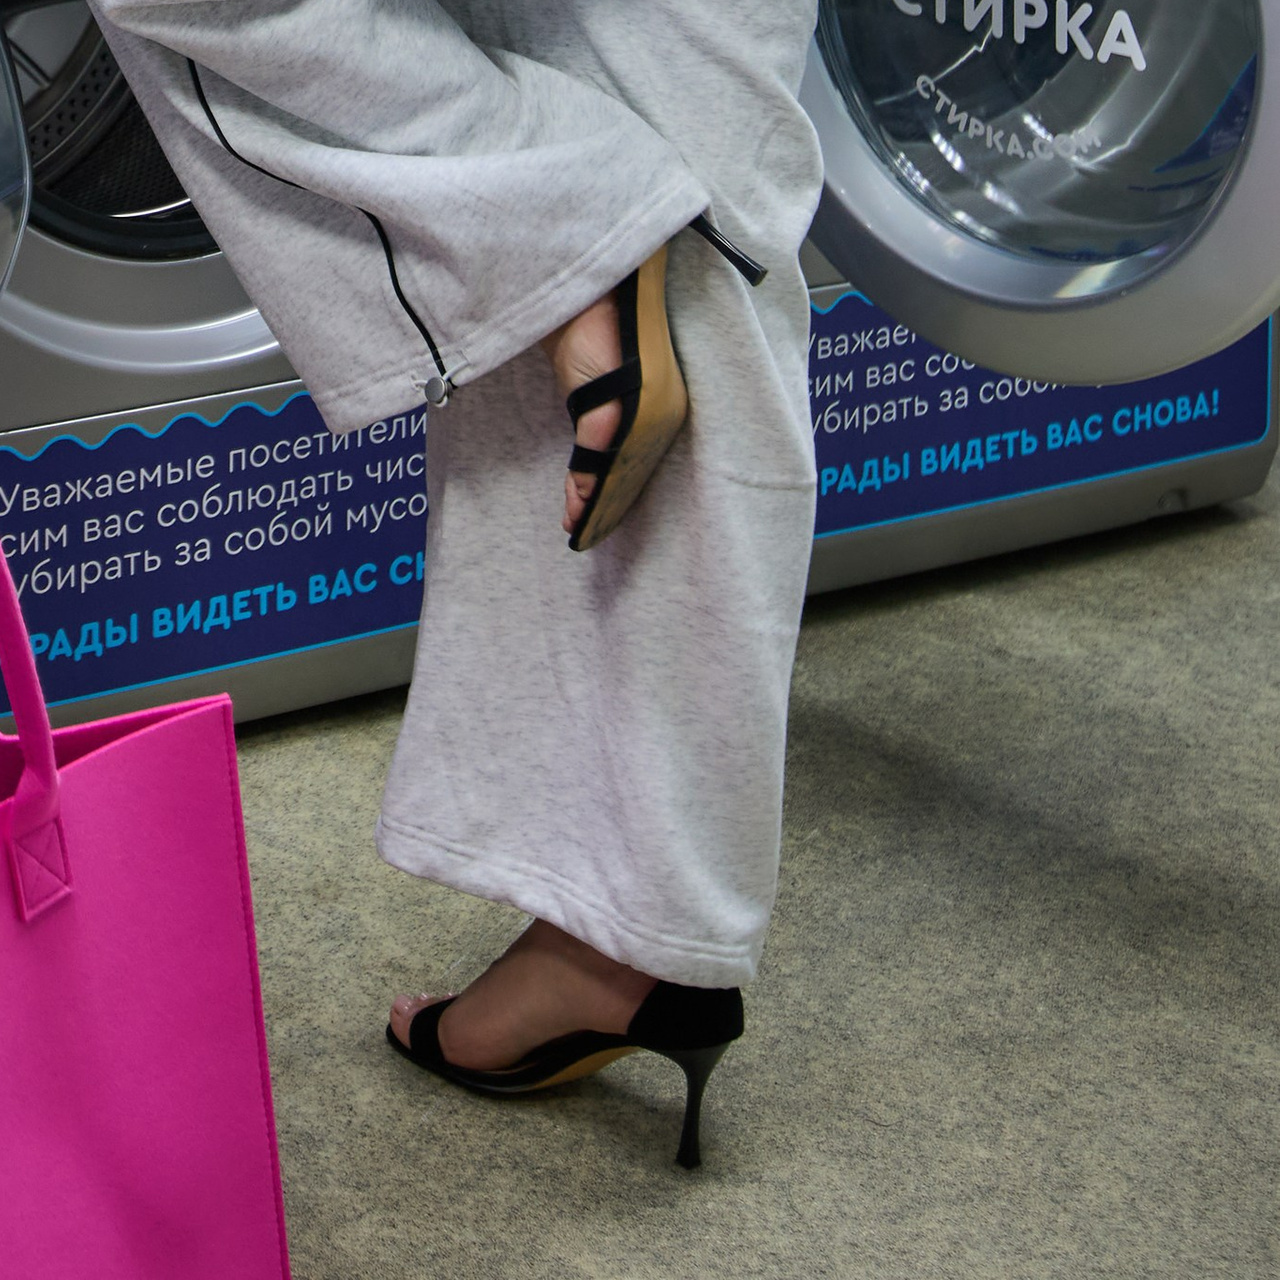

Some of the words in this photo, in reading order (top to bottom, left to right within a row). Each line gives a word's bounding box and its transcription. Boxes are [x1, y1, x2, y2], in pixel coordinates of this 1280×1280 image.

[867, 360, 914, 388] вас
[940, 387, 968, 411] за
[821, 452, 909, 495] РАДЫ
[921, 429, 1037, 475] ВИДЕТЬ
[1047, 414, 1102, 449] ВАС
[1113, 389, 1218, 435] СНОВА!
[84, 510, 144, 542] вас
[158, 470, 352, 527] соблюдать
[175, 539, 210, 565] за
[225, 512, 331, 554] собой
[32, 614, 138, 663] РАДЫ
[153, 582, 297, 637] ВИДЕТЬ
[309, 563, 377, 604] ВАС
